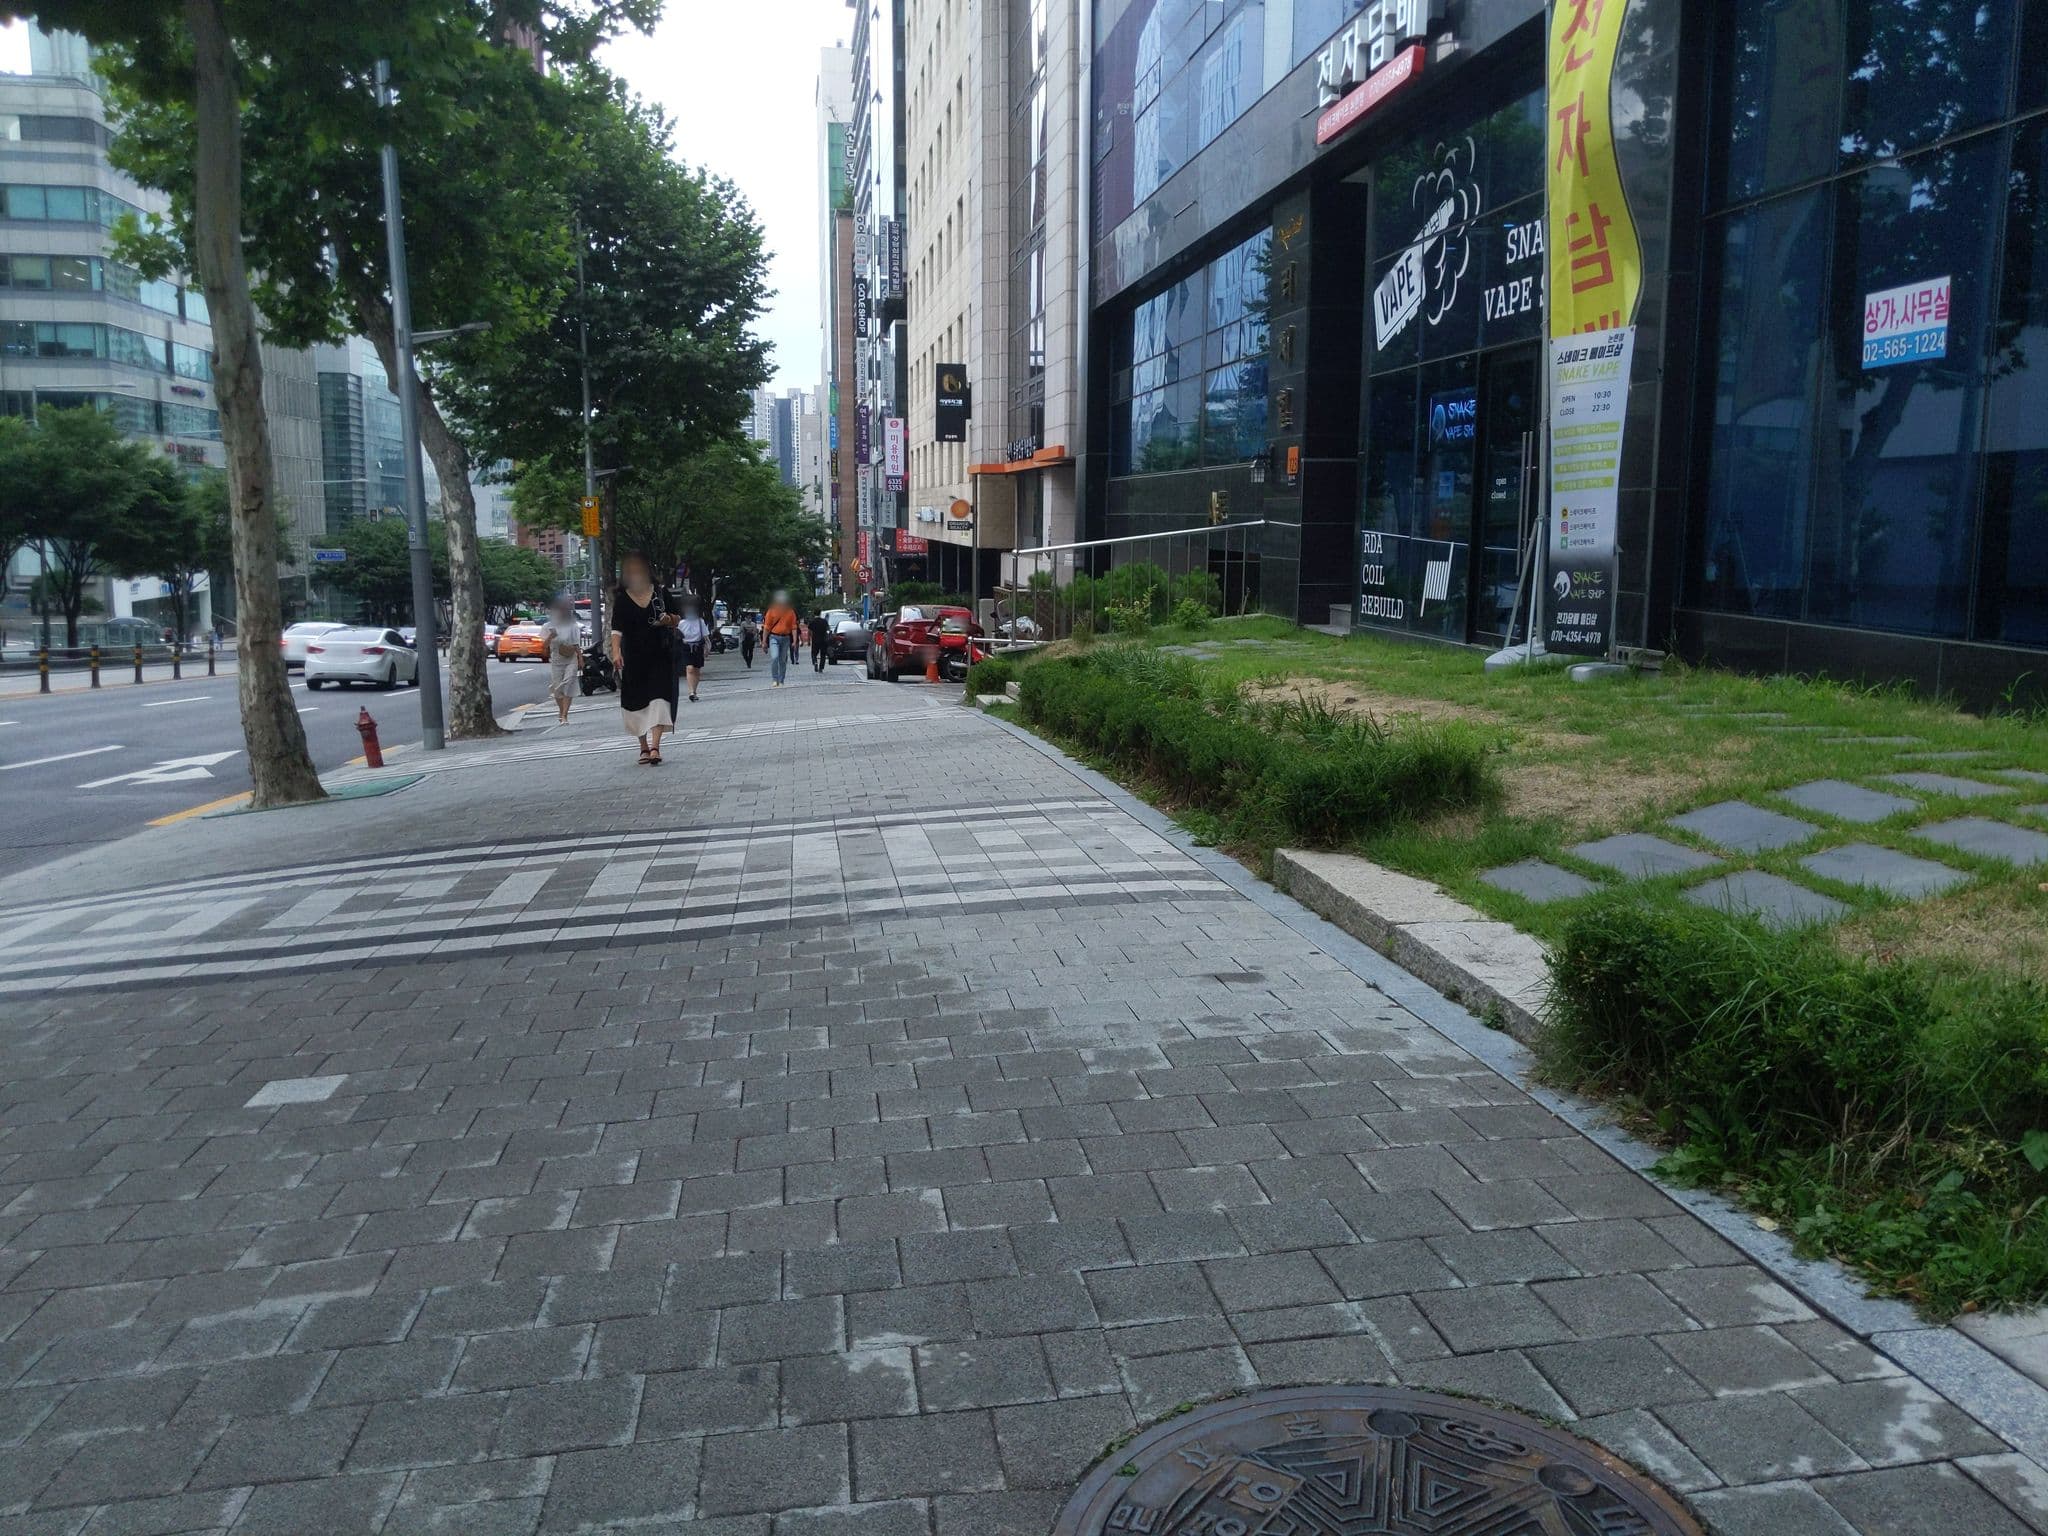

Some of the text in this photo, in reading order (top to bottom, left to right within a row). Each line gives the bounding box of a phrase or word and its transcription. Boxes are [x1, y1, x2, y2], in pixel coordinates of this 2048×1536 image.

[1557, 0, 1621, 334] 전자담
[1484, 276, 1533, 322] VAPE
[1865, 285, 1950, 333] 상가,사무실
[1557, 348, 1588, 365] 스네이크
[1863, 331, 1946, 362] 02-565-1224
[1562, 390, 1612, 404] OPEN 10:30
[1448, 400, 1476, 419] SNAKE
[1592, 404, 1611, 412] 22:30
[1364, 533, 1383, 554] RDA
[859, 572, 870, 583] 약
[1362, 564, 1385, 585] COIL
[1361, 594, 1404, 619] REBUILD
[1551, 630, 1602, 644] 070-4354-4978
